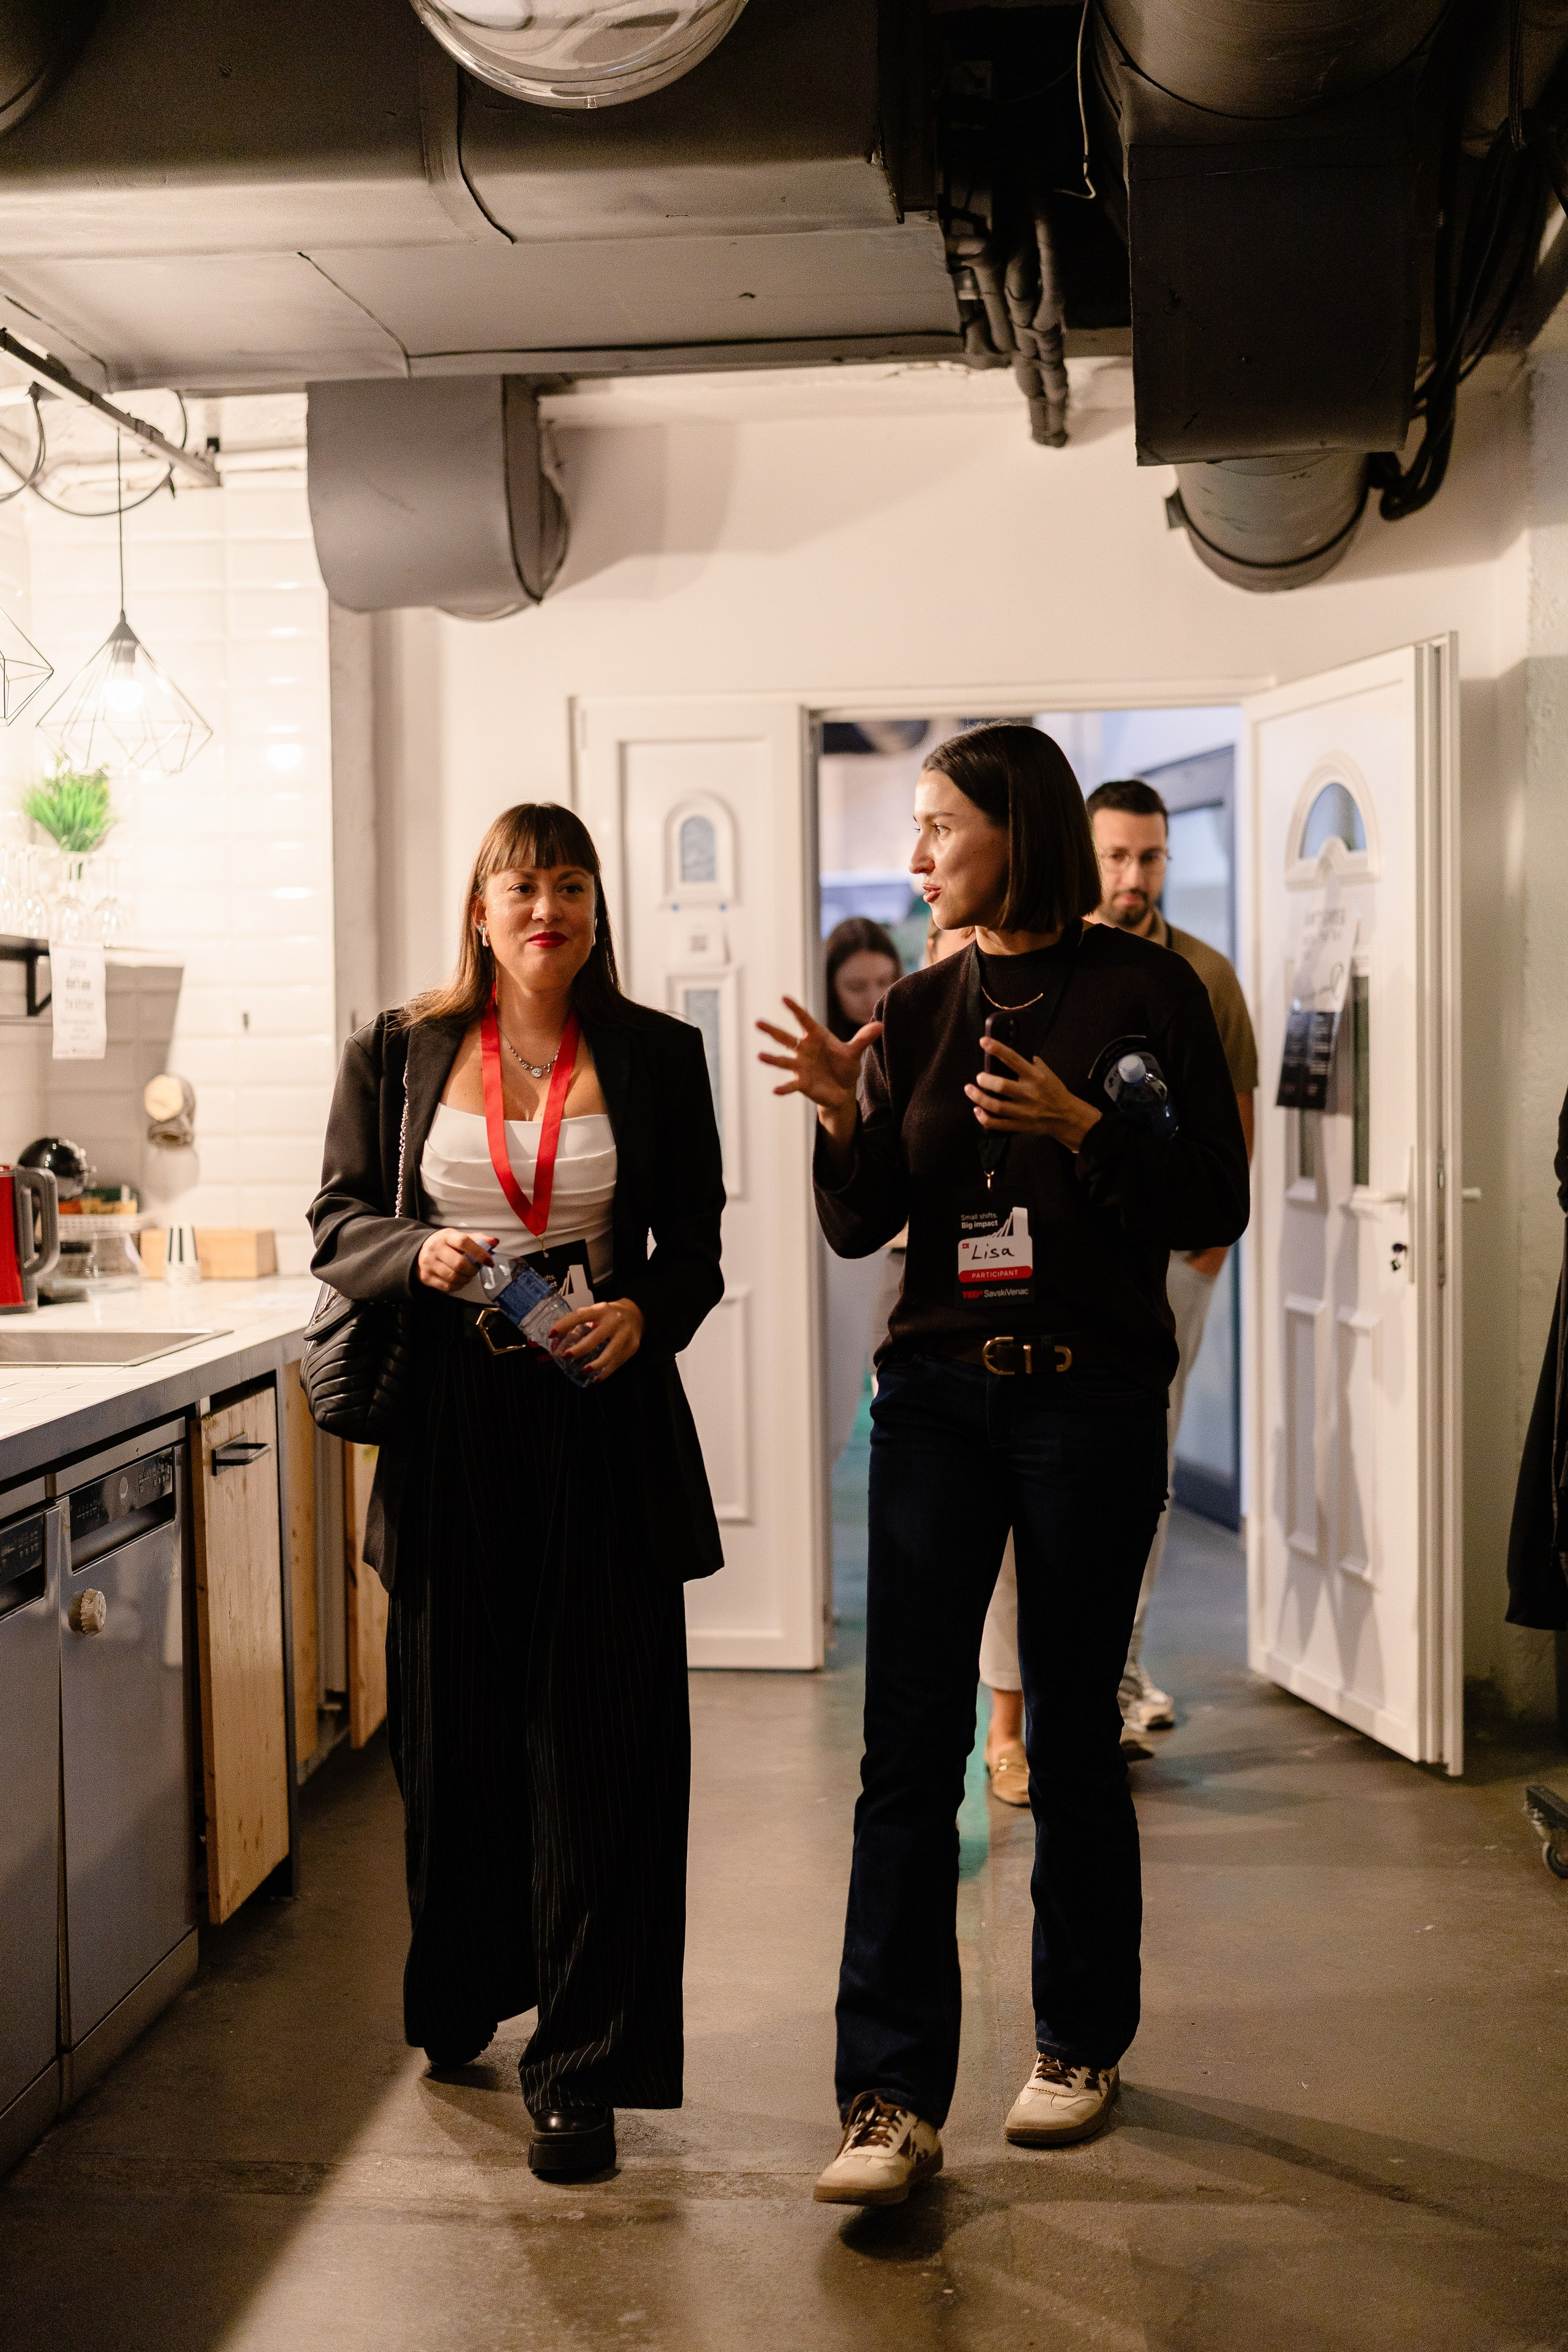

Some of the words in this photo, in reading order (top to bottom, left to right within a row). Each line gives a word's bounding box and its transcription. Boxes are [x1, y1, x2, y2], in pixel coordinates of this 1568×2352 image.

[81, 980, 91, 990] use
[962, 1221, 973, 1230] Big
[974, 1219, 998, 1229] impact
[972, 1243, 1014, 1260] Lisa
[972, 1269, 1018, 1279] PARTICIPANT
